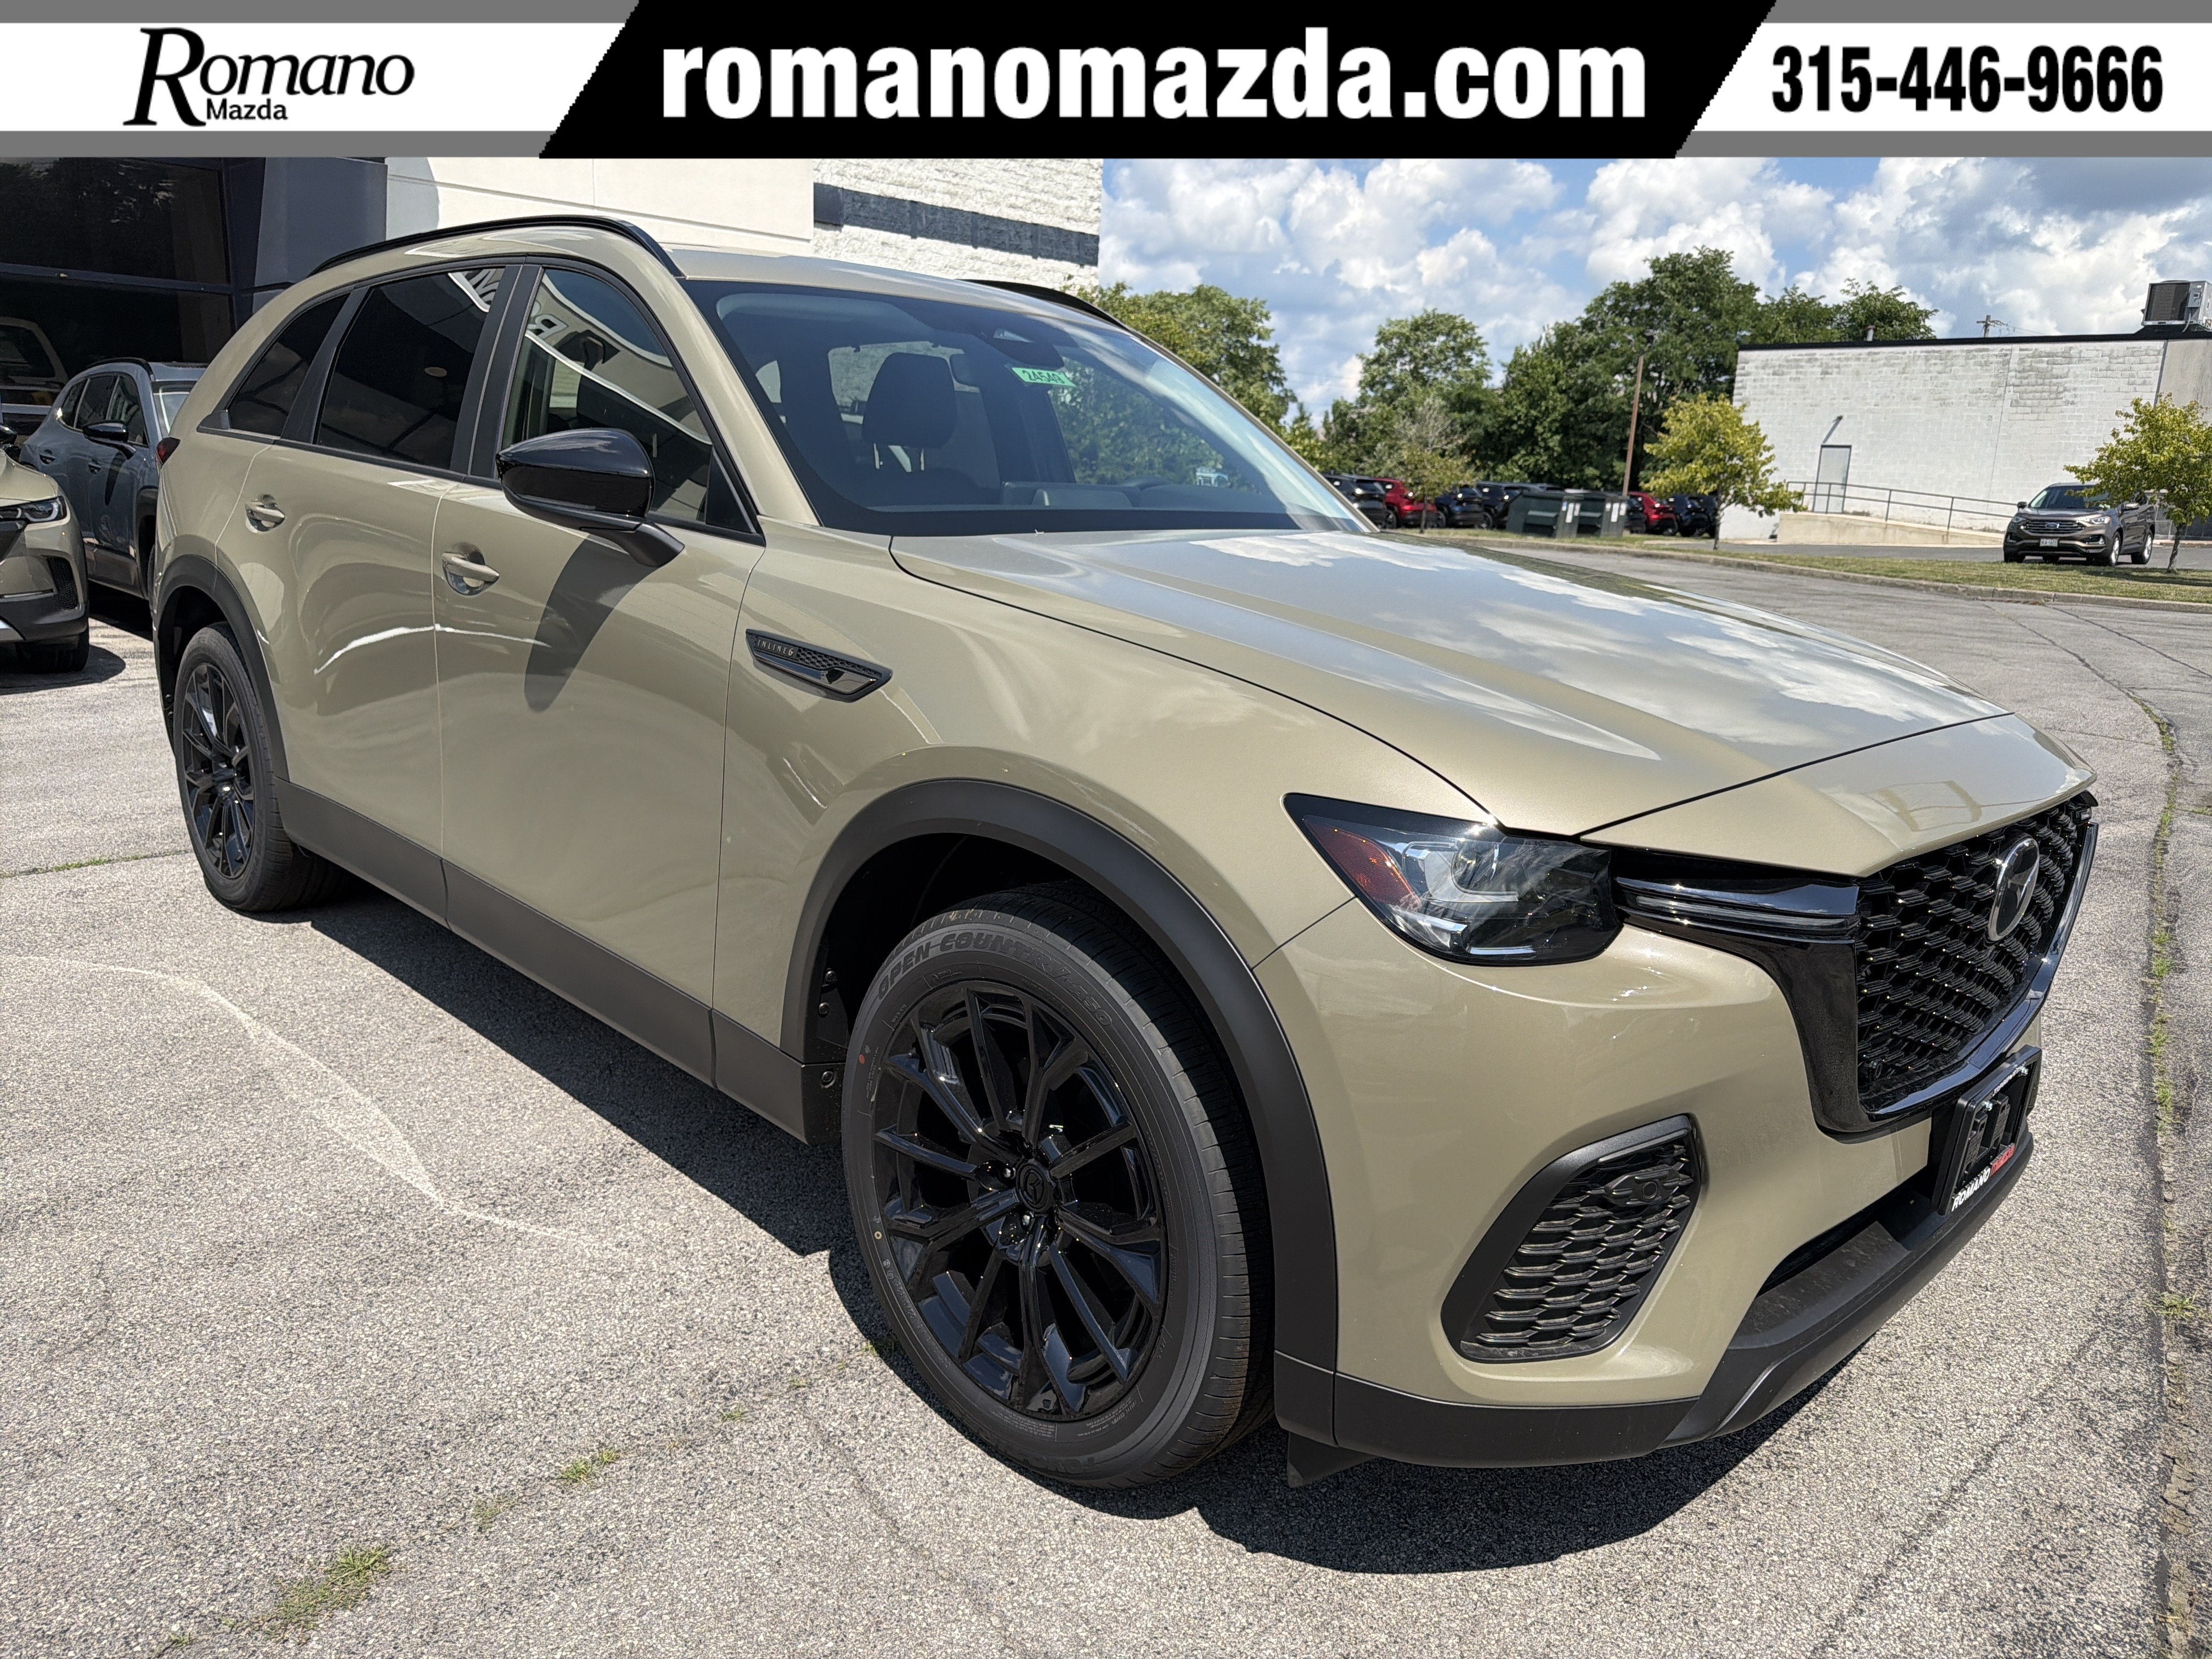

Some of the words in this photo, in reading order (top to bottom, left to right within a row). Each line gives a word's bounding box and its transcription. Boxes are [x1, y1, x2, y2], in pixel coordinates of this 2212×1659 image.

[878, 941, 932, 1000] OPEN
[939, 932, 1071, 979] COUNTRY
[1951, 1167, 1991, 1212] ROMANO
